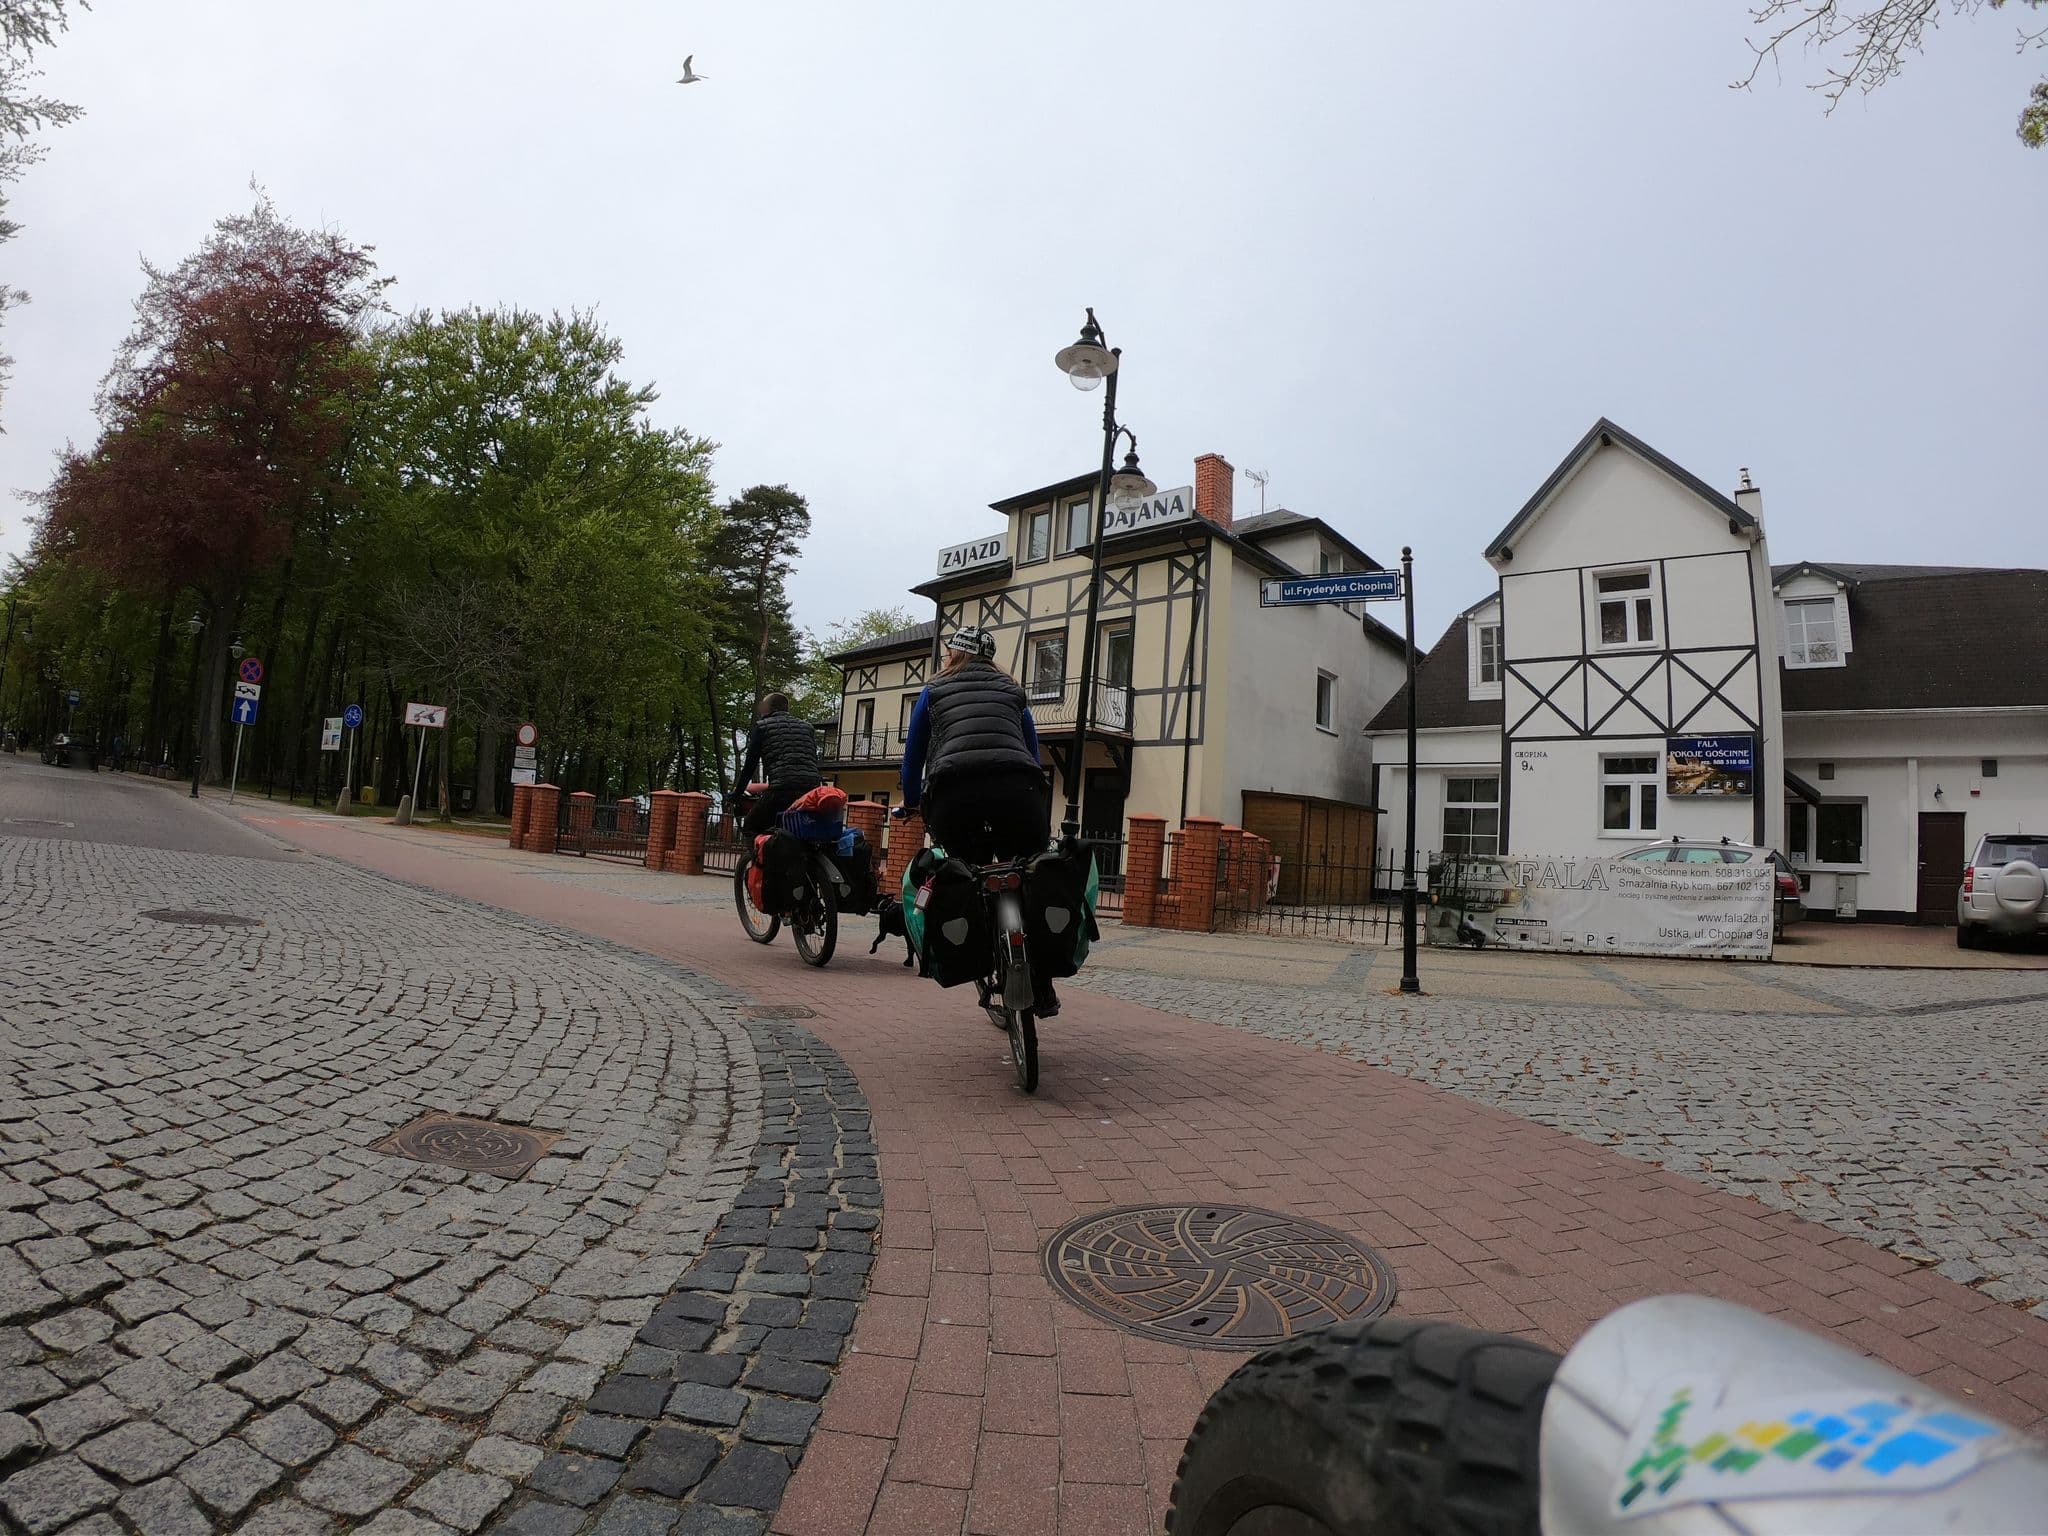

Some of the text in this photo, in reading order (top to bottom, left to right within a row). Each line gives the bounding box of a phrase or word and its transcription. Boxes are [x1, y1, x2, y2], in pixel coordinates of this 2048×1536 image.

[1104, 495, 1185, 529] DAJANA
[943, 540, 1001, 569] ZAJAZD
[1284, 581, 1393, 596] ul.Fryderyka Chopina
[1697, 740, 1718, 748] FALA
[1670, 749, 1750, 758] POKOJE GOŚCINNE
[1515, 861, 1610, 891] FALA
[1609, 864, 1641, 875] Pokoje
[1690, 869, 1712, 877] kom.
[1715, 868, 1733, 877] 508
[1734, 868, 1752, 877] 318
[1670, 880, 1689, 891] Ryb
[1692, 881, 1714, 891] kom.
[1717, 881, 1734, 890] 667
[1736, 881, 1752, 891] 102
[1754, 881, 1771, 891] 155
[1697, 912, 1770, 924] www.fala2ta.pl
[1659, 928, 1691, 939] Ustka,
[1709, 928, 1753, 941] Chopina
[1756, 930, 1769, 940] 9a
